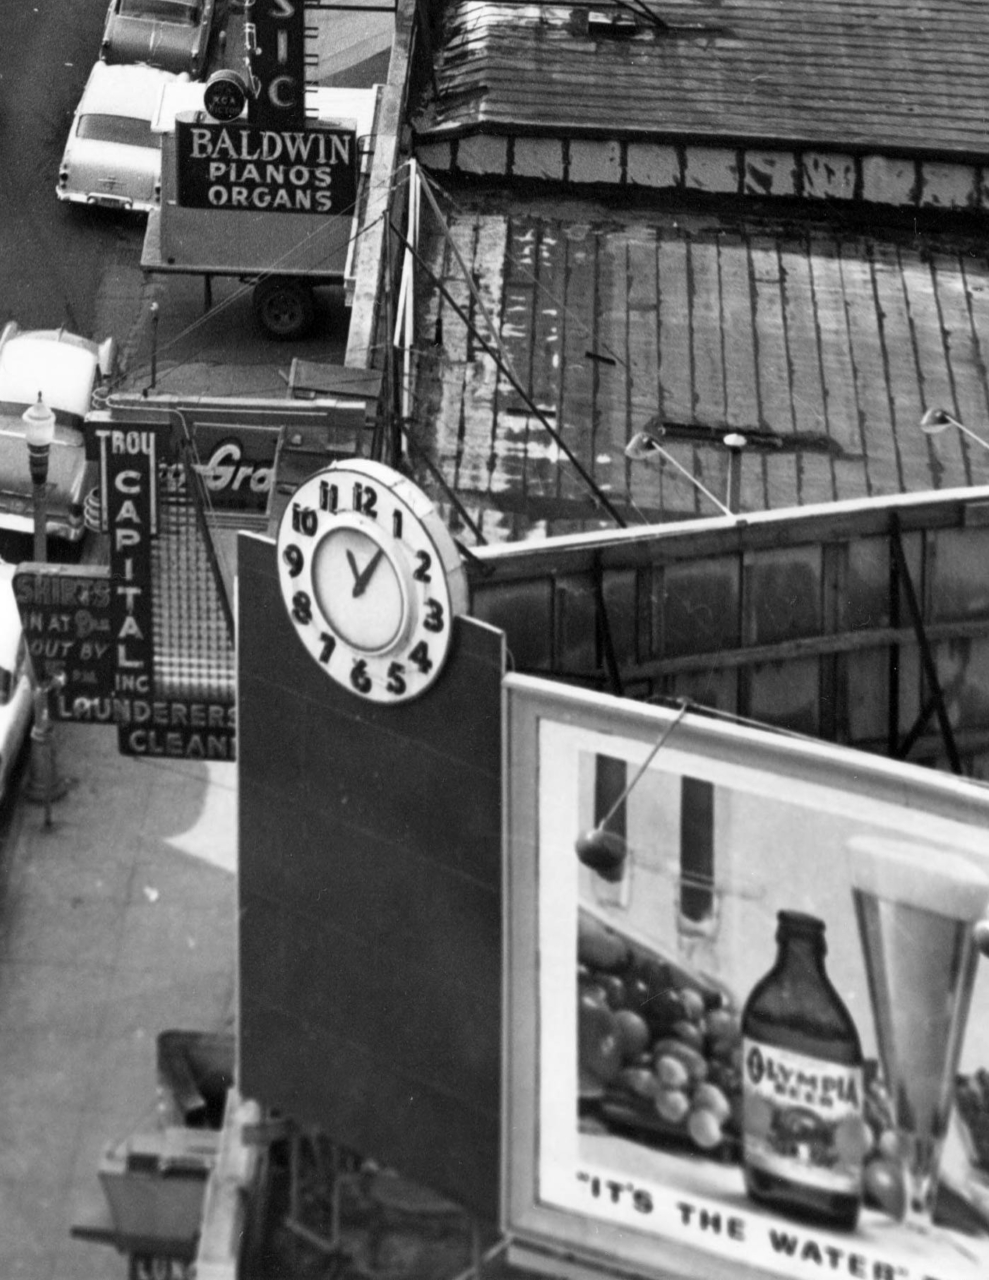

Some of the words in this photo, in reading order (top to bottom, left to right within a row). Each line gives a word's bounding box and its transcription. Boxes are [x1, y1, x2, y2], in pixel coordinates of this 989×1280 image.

[189, 127, 352, 165] BALDWIN
[209, 162, 333, 187] PIANOS
[208, 185, 333, 211] ORGANS
[319, 480, 338, 515] 11
[353, 482, 378, 519] 12
[292, 502, 318, 537] 10
[393, 508, 403, 539] 1
[114, 470, 144, 667] CAPITAL
[283, 544, 304, 578] 9
[413, 550, 432, 583] 2
[15, 575, 111, 608] SHIRTS
[292, 590, 312, 625] 8
[48, 615, 71, 631] AT
[423, 597, 444, 633] 3
[30, 640, 73, 659] OUT
[80, 642, 110, 660] BY
[319, 631, 336, 664] 7
[408, 640, 433, 674] 4
[115, 674, 149, 692] INC
[350, 659, 372, 694] 6
[386, 661, 406, 695] 5
[676, 1201, 746, 1241] THE
